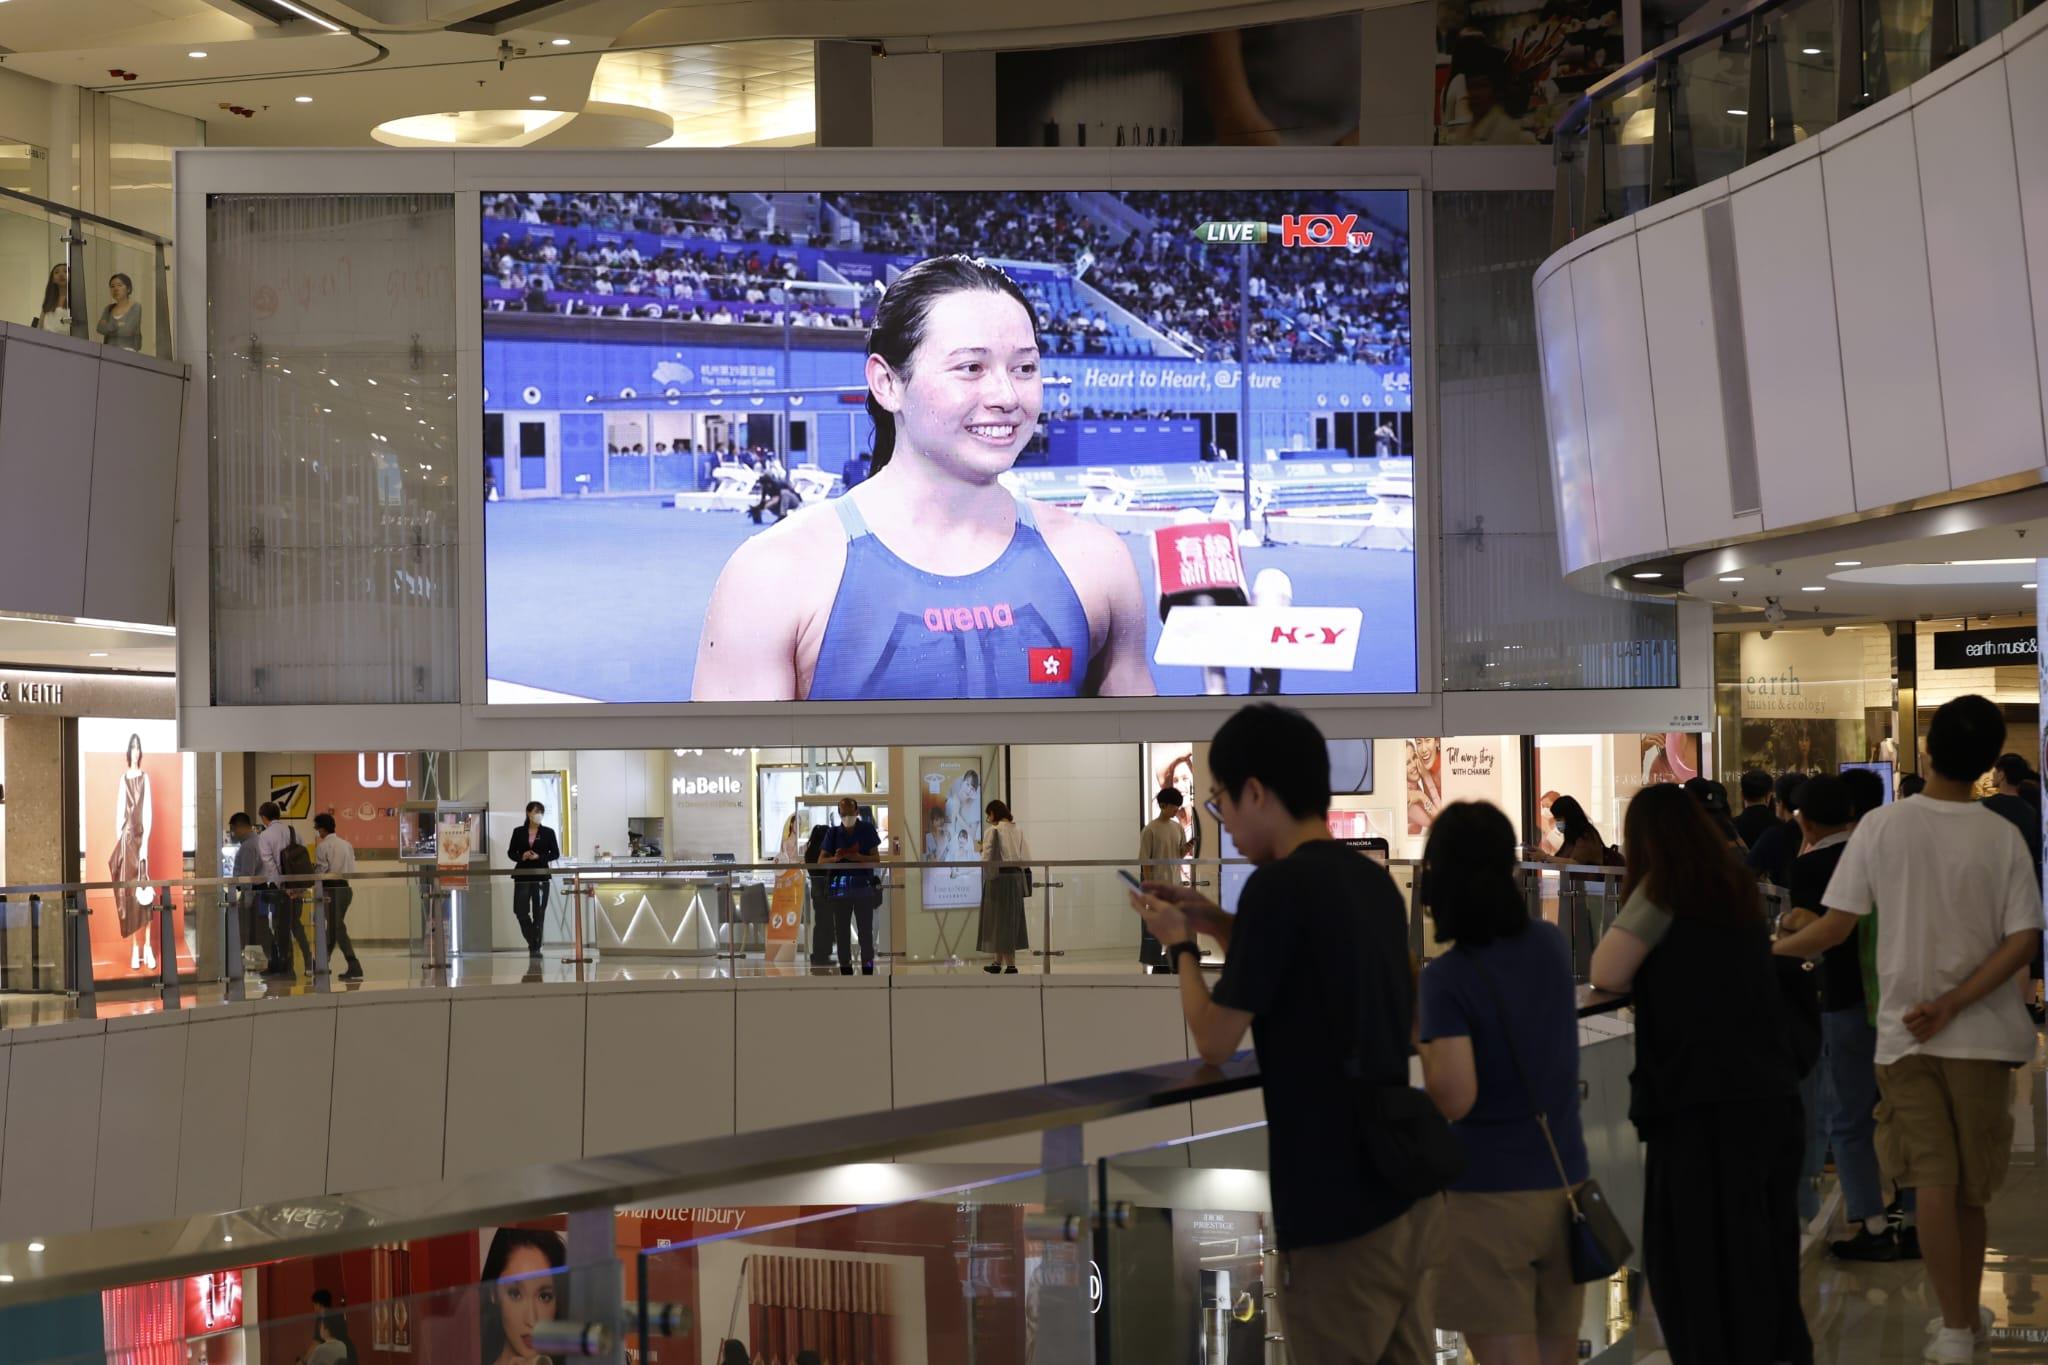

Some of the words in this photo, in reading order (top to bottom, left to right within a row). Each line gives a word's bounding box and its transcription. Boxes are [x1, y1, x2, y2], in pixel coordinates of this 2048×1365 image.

[1207, 224, 1255, 241] LIVE
[1282, 214, 1357, 247] HOY
[1084, 368, 1133, 388] Heart
[1139, 370, 1156, 388] to
[1160, 370, 1211, 393] Heart,
[1214, 370, 1281, 389] @Fture
[923, 602, 1013, 632] arena
[1270, 626, 1347, 645] HY
[1965, 639, 1997, 656] earth
[1746, 664, 1800, 696] earth
[0, 682, 11, 702] &
[19, 682, 63, 704] KEITH
[672, 776, 741, 795] MaBelle
